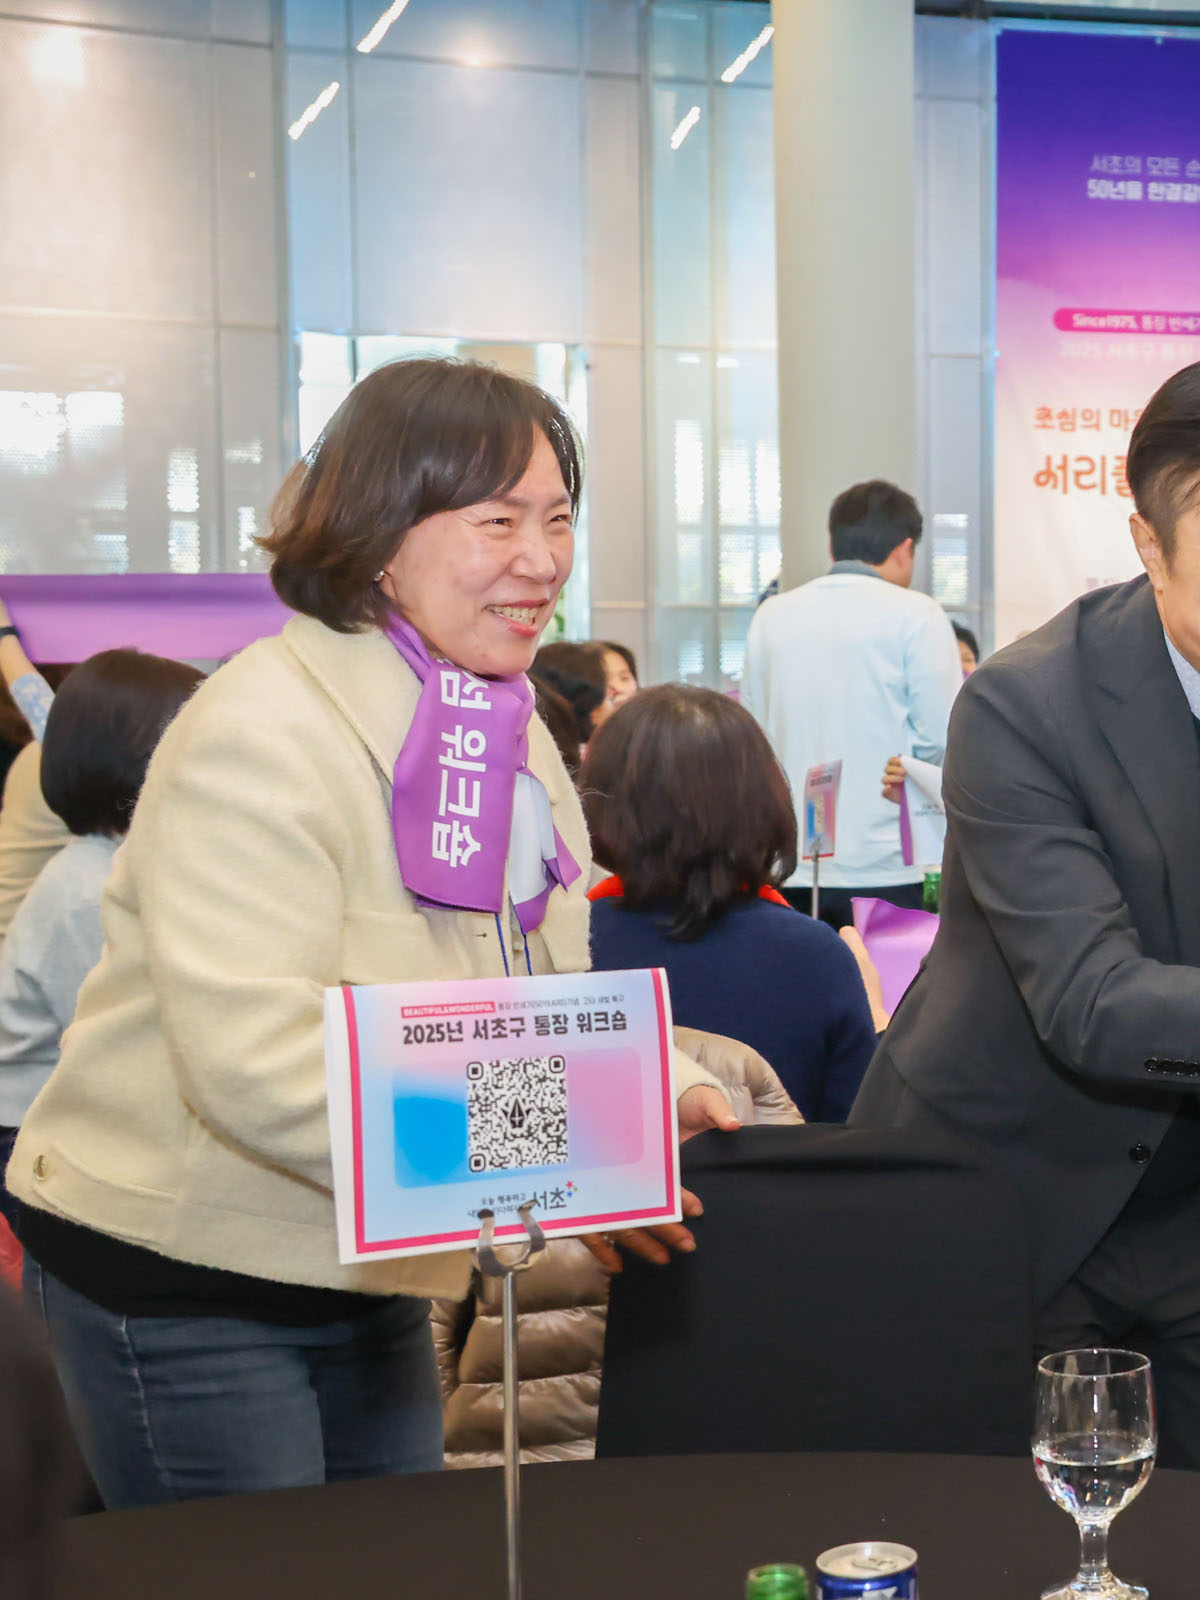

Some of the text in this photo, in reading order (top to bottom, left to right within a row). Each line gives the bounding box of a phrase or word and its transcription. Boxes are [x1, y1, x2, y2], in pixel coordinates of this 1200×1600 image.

[1090, 154, 1142, 174] 서초의
[1146, 156, 1180, 177] 모든
[1033, 405, 1101, 433] 초심의
[431, 725, 487, 868] 워크숍
[402, 1010, 628, 1045] 2025년 서초구 통장 워크숍
[532, 1187, 568, 1211] 서초
